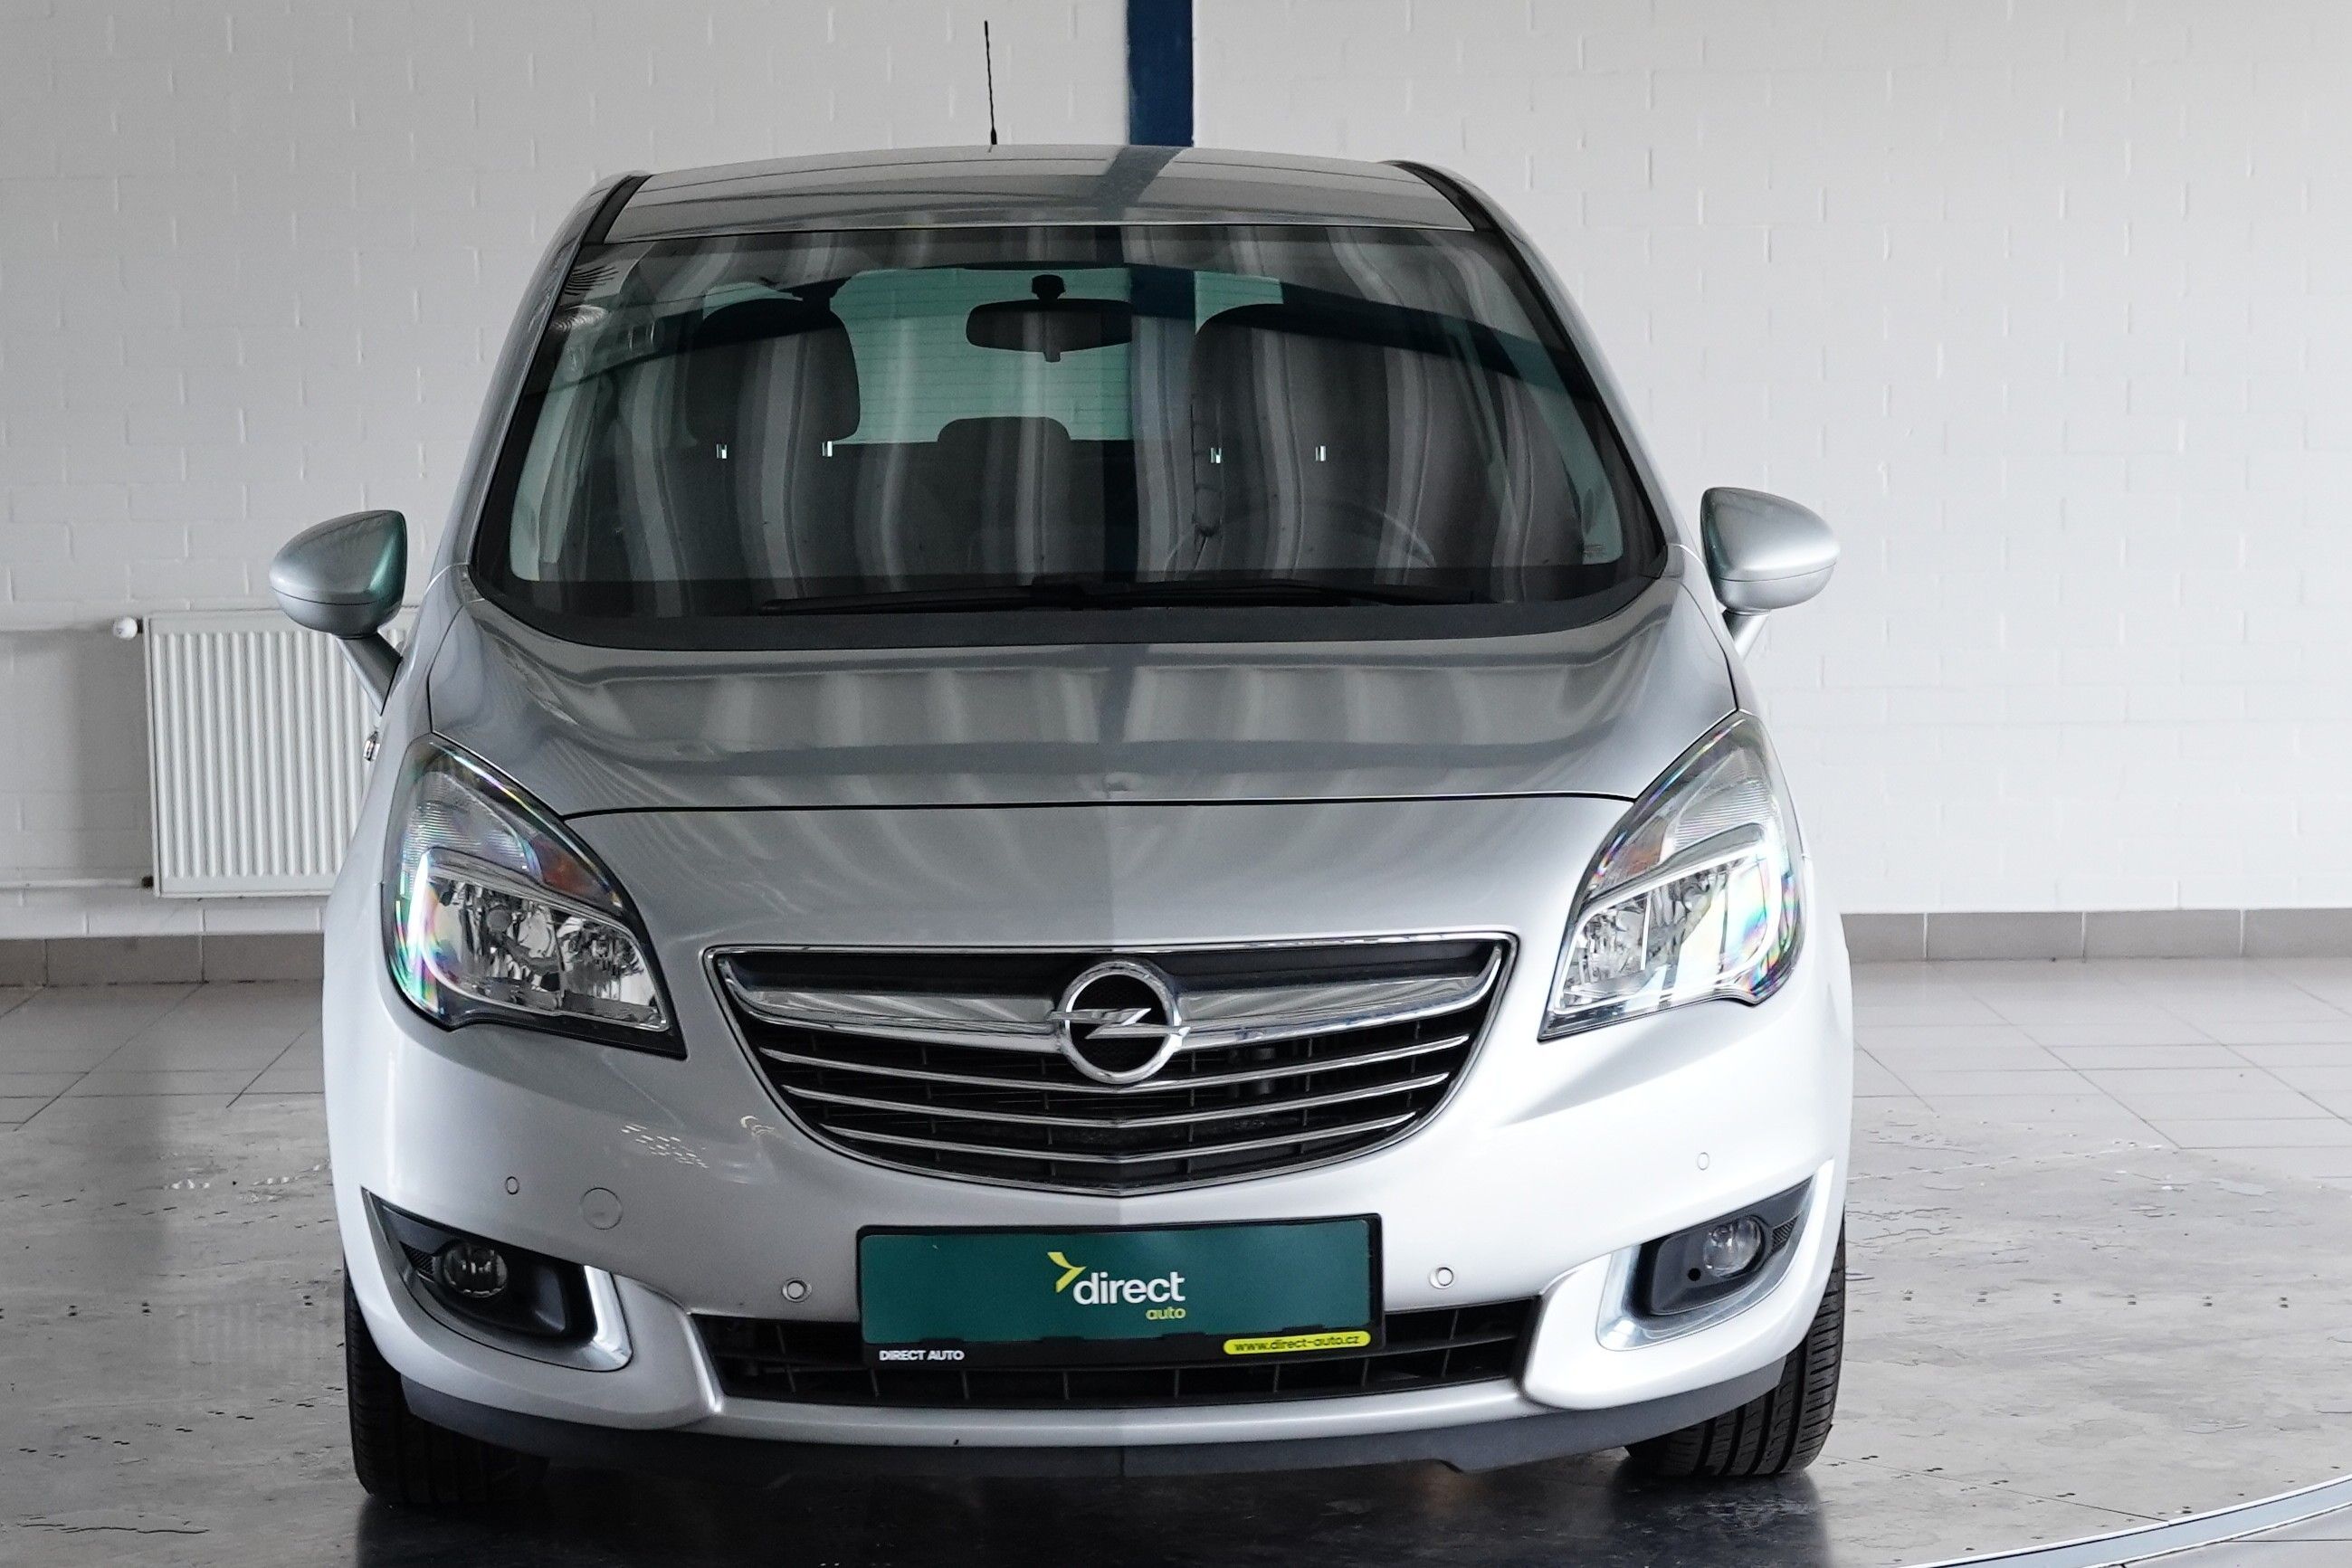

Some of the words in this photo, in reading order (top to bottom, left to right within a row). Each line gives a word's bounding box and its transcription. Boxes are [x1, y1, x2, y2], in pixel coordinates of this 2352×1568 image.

[1072, 1271, 1186, 1305] direct
[1145, 1307, 1186, 1320] auto
[1233, 1335, 1360, 1352] www.direct-auto.cz
[879, 1350, 927, 1361] DIRECT
[927, 1350, 965, 1361] AUTO
